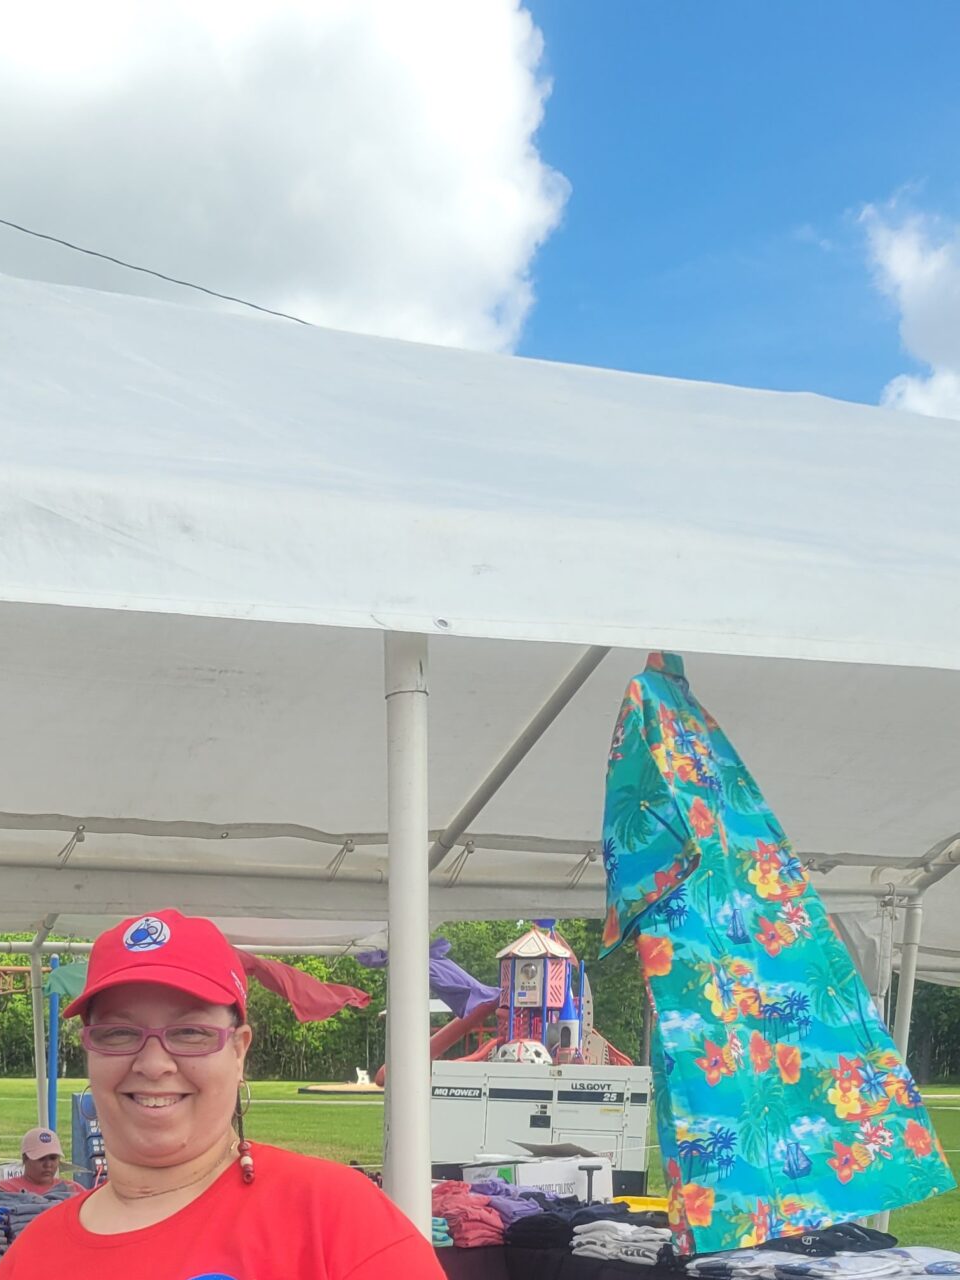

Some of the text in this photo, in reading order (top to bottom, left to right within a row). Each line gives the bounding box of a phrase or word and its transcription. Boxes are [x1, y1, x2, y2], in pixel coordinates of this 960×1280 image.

[434, 1087, 480, 1097] MQ POWER
[602, 1093, 617, 1101] 25
